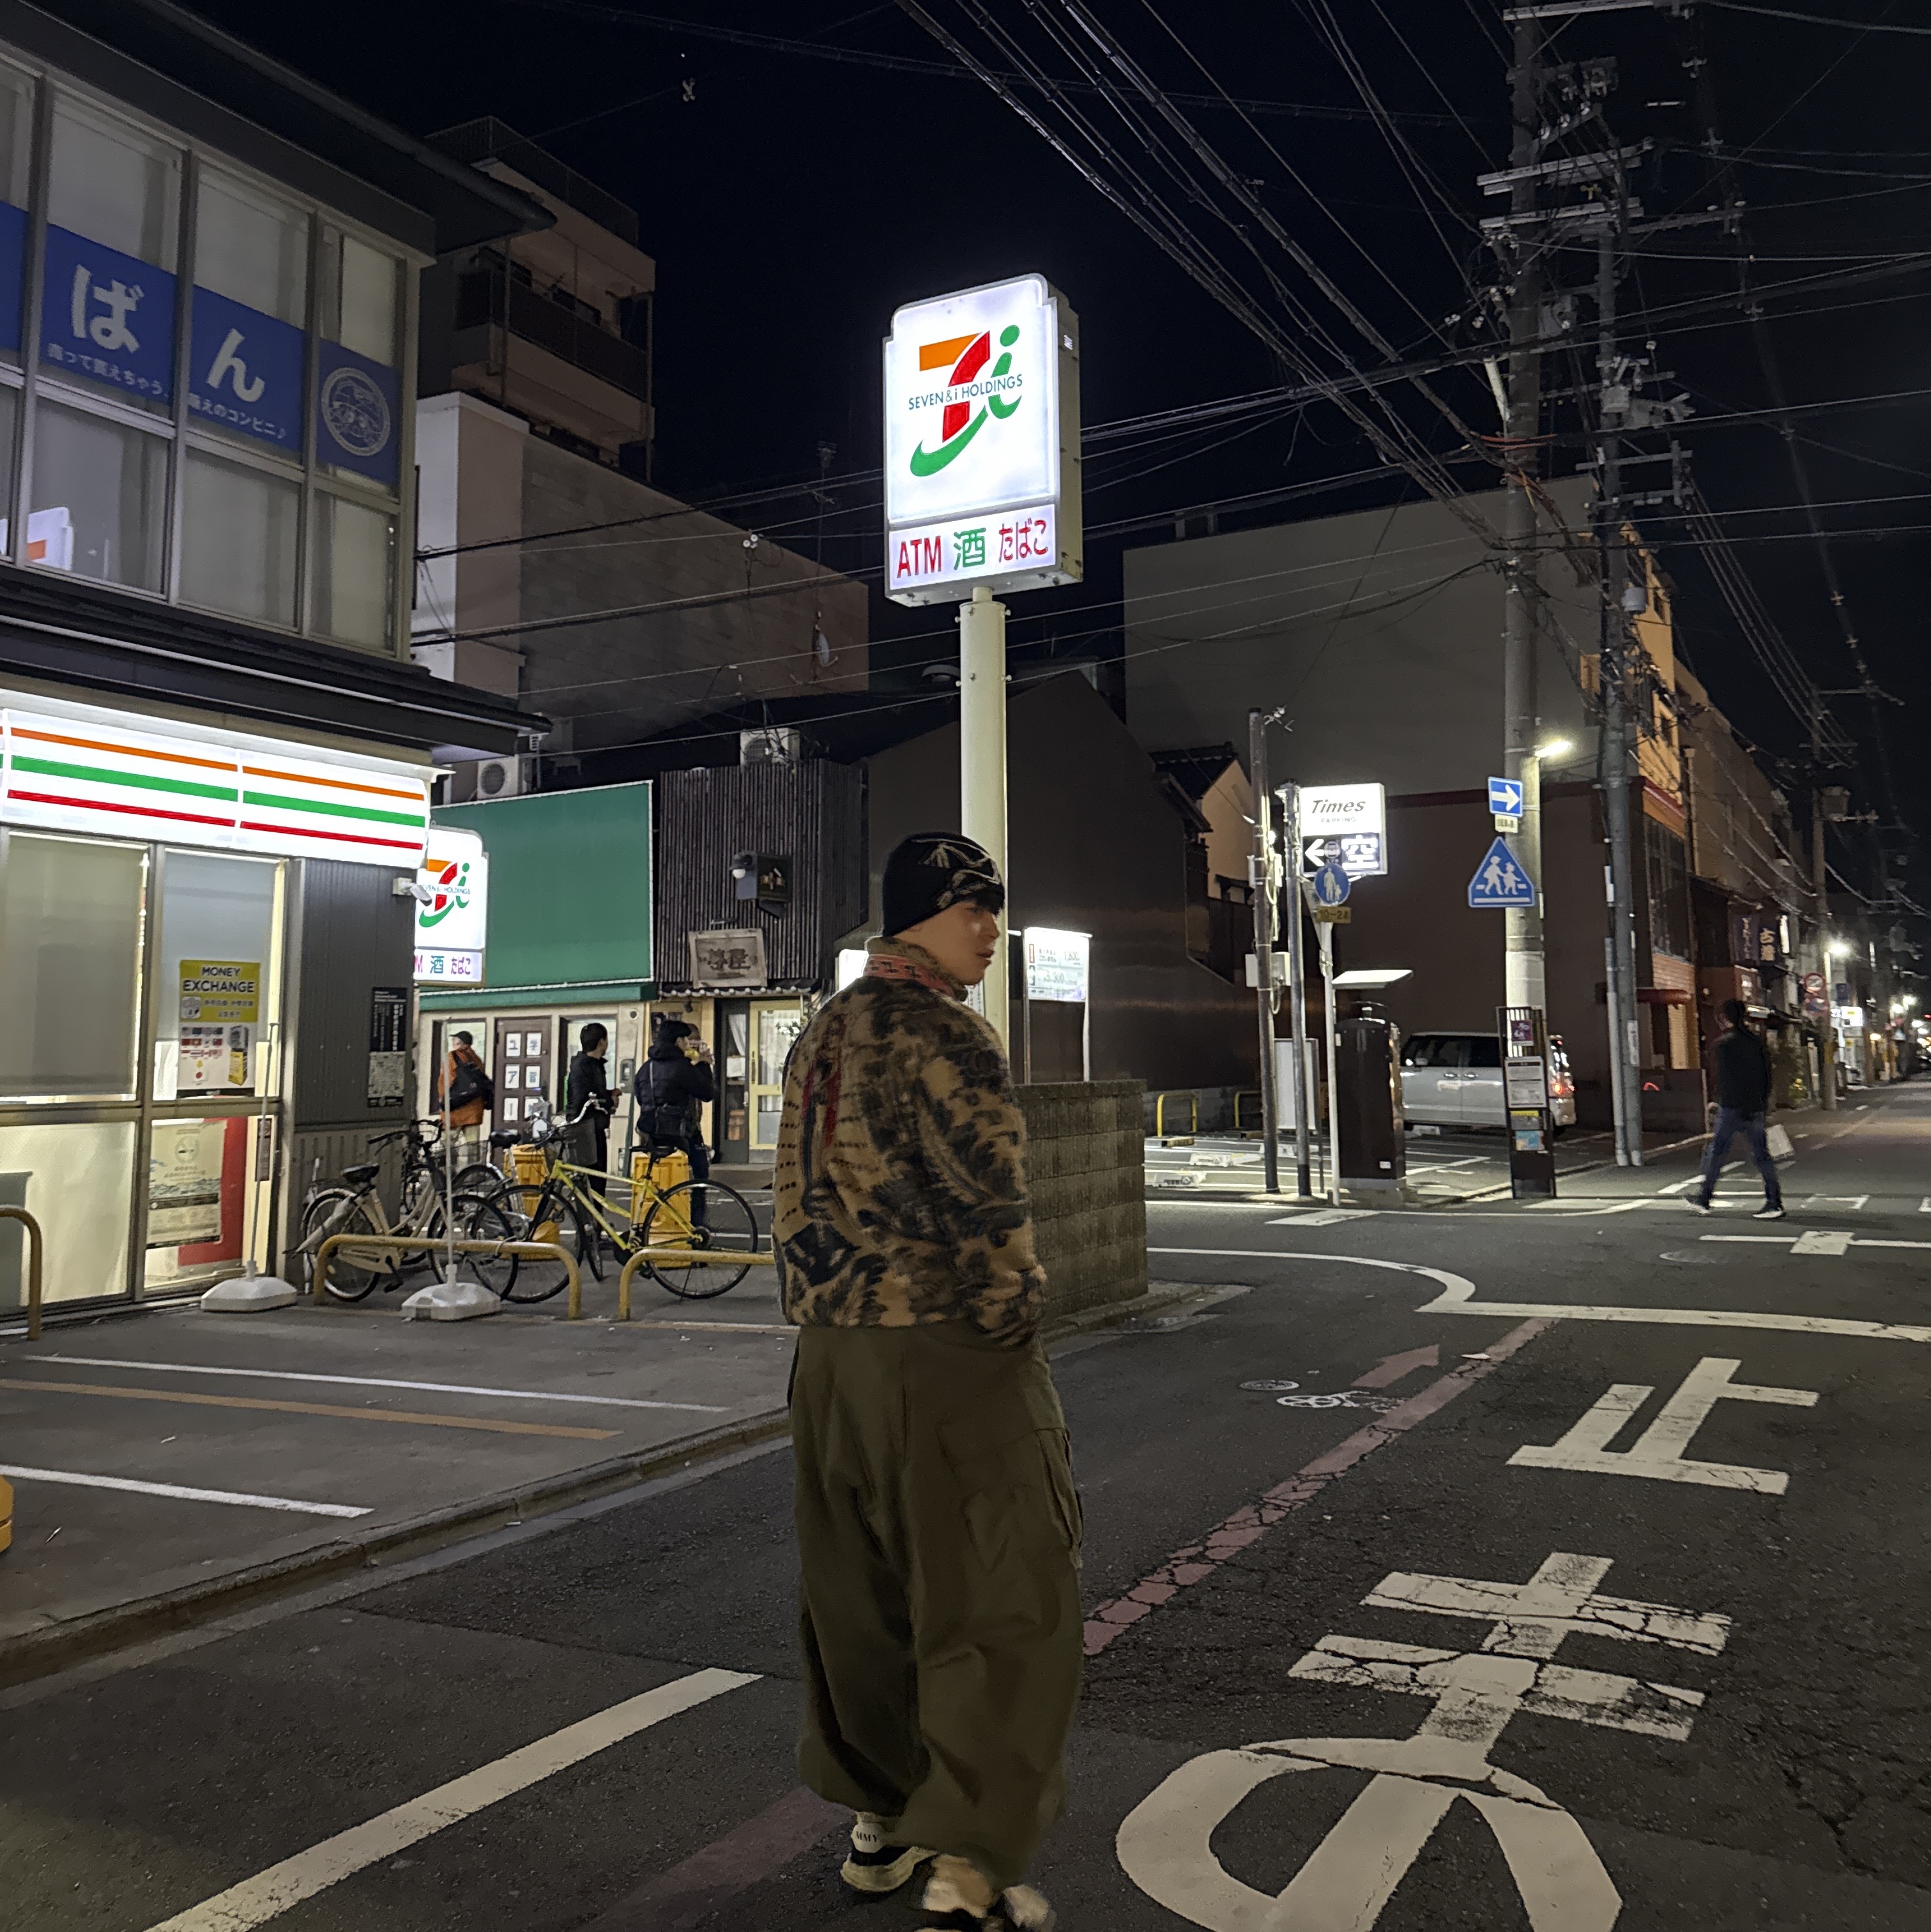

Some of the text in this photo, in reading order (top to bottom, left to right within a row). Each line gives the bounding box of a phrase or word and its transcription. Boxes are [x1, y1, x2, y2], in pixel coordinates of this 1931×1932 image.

[962, 374, 1023, 400] HOLDINGS
[896, 517, 1048, 578] ATM 酒 たばこ
[1312, 799, 1366, 814] Times
[1341, 834, 1380, 870] 空
[202, 966, 241, 977] MONEY
[430, 955, 445, 973] 酒
[451, 955, 471, 975] たばこ
[183, 980, 254, 993] EXCHANGE
